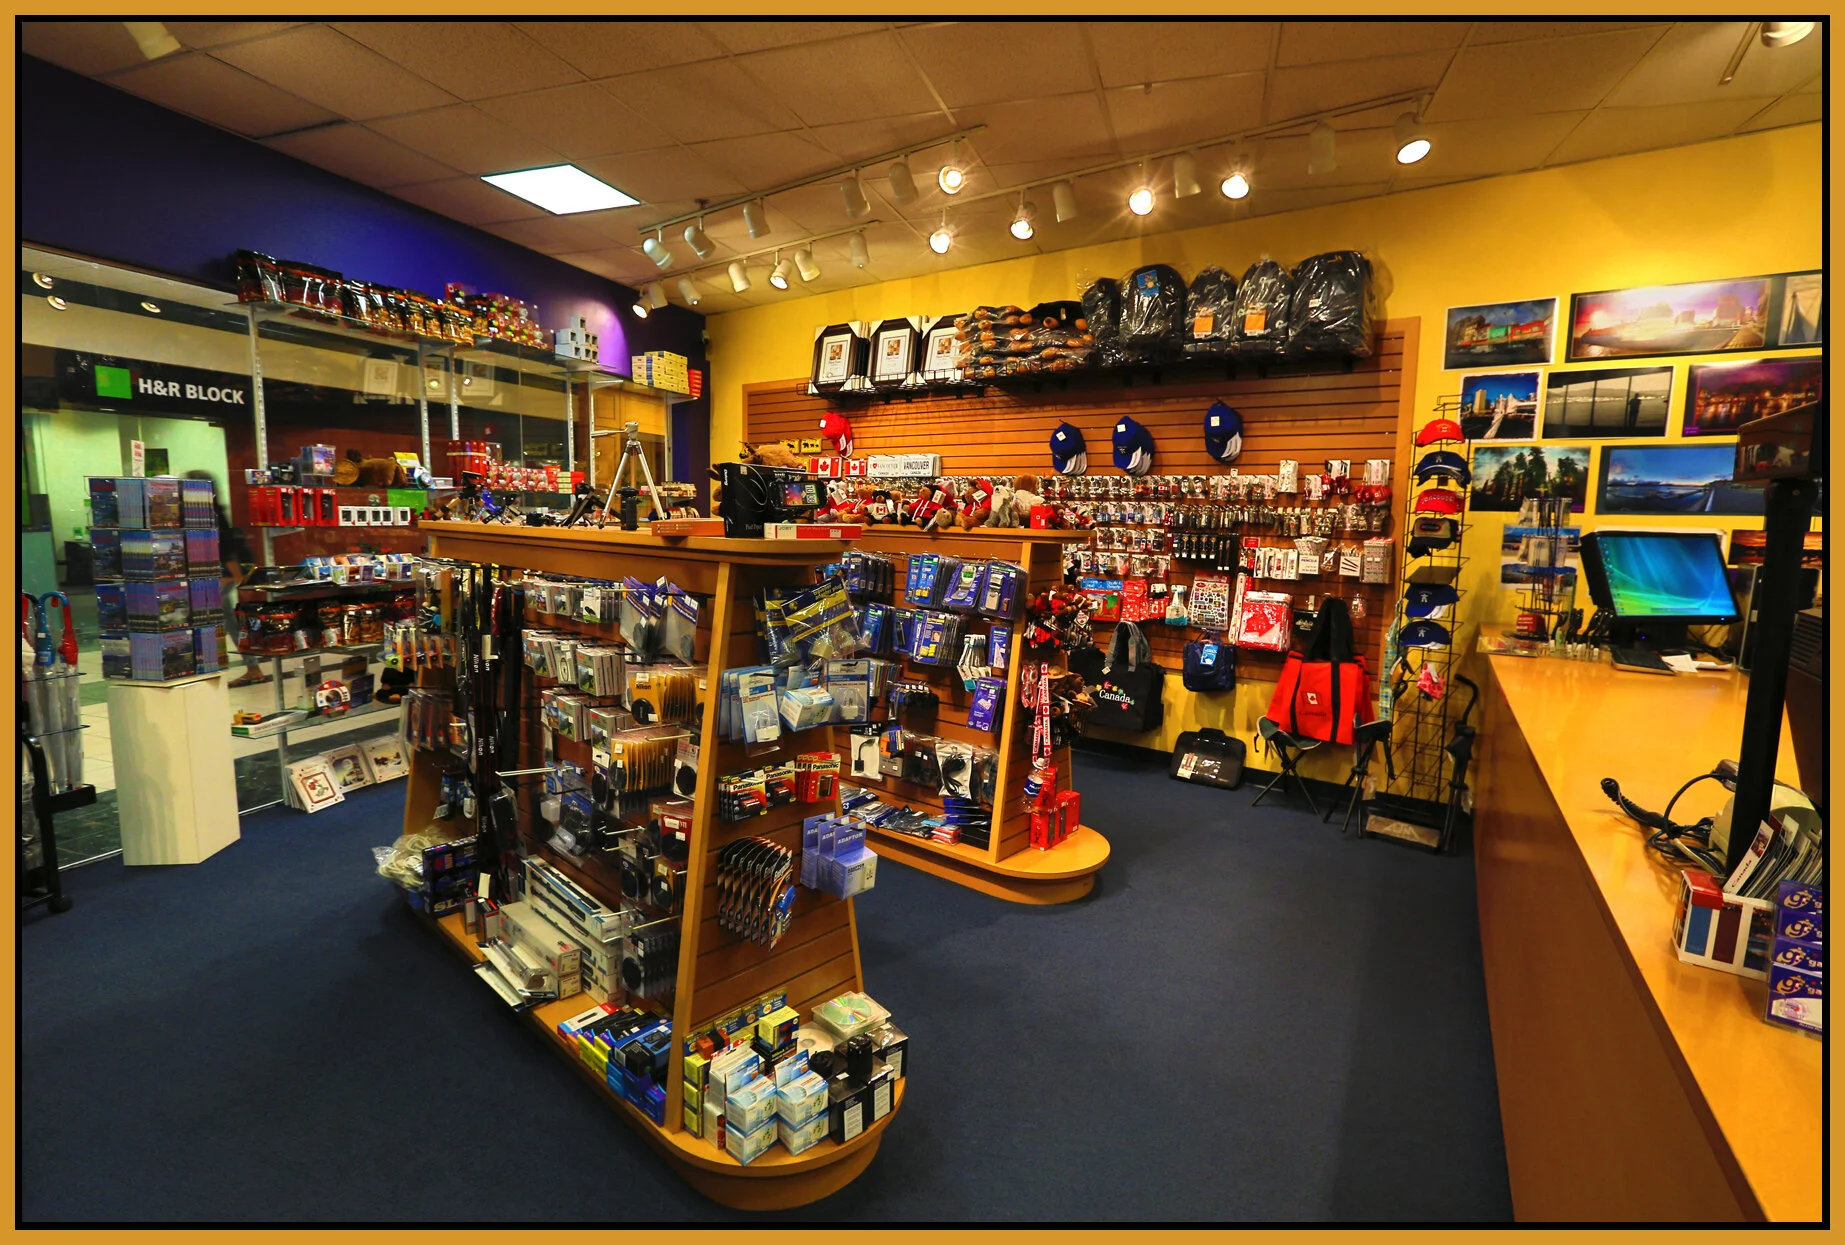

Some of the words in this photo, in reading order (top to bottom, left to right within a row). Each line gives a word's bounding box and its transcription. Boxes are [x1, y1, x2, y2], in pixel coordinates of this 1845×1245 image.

[138, 378, 181, 398] H&R
[185, 384, 245, 404] BLOCK
[903, 460, 930, 470] VANCOUVER
[1099, 689, 1131, 703] Canada
[837, 832, 863, 844] ADAPTOR
[1731, 860, 1752, 888] Canada
